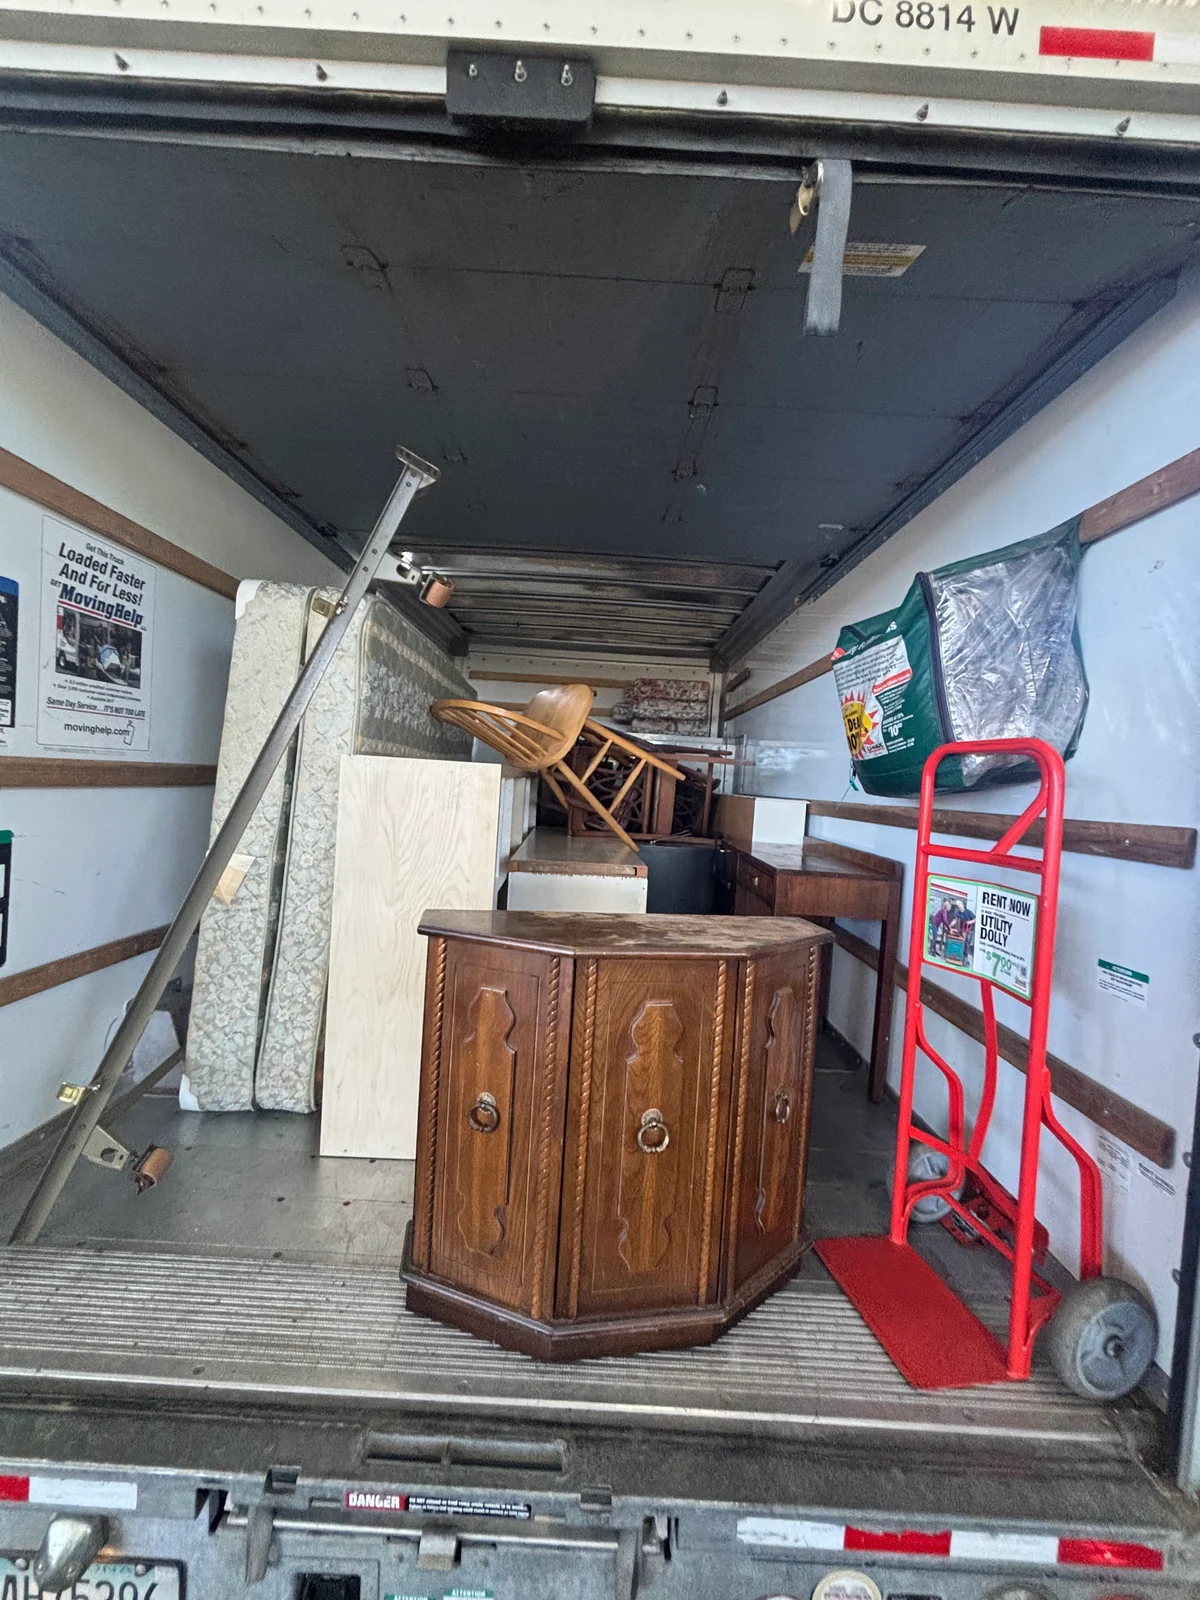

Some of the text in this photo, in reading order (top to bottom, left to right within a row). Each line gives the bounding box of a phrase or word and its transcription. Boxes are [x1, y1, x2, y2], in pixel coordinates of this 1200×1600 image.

[832, 0, 1019, 36] DC 8814 W
[58, 542, 146, 590] Loaded Faster
[98, 547, 108, 558] This
[110, 553, 124, 565] Truck
[58, 563, 142, 606] And For Less!
[47, 697, 64, 706] Same
[65, 700, 76, 709] Day
[64, 723, 130, 736] movinghelp.com
[982, 891, 1007, 910] RENT
[1009, 899, 1031, 917] NOW
[981, 914, 1013, 935] UTILITY
[980, 927, 1008, 948] DOLLY
[349, 1493, 400, 1509] DANGER
[452, 1589, 486, 1597] ATTENTION
